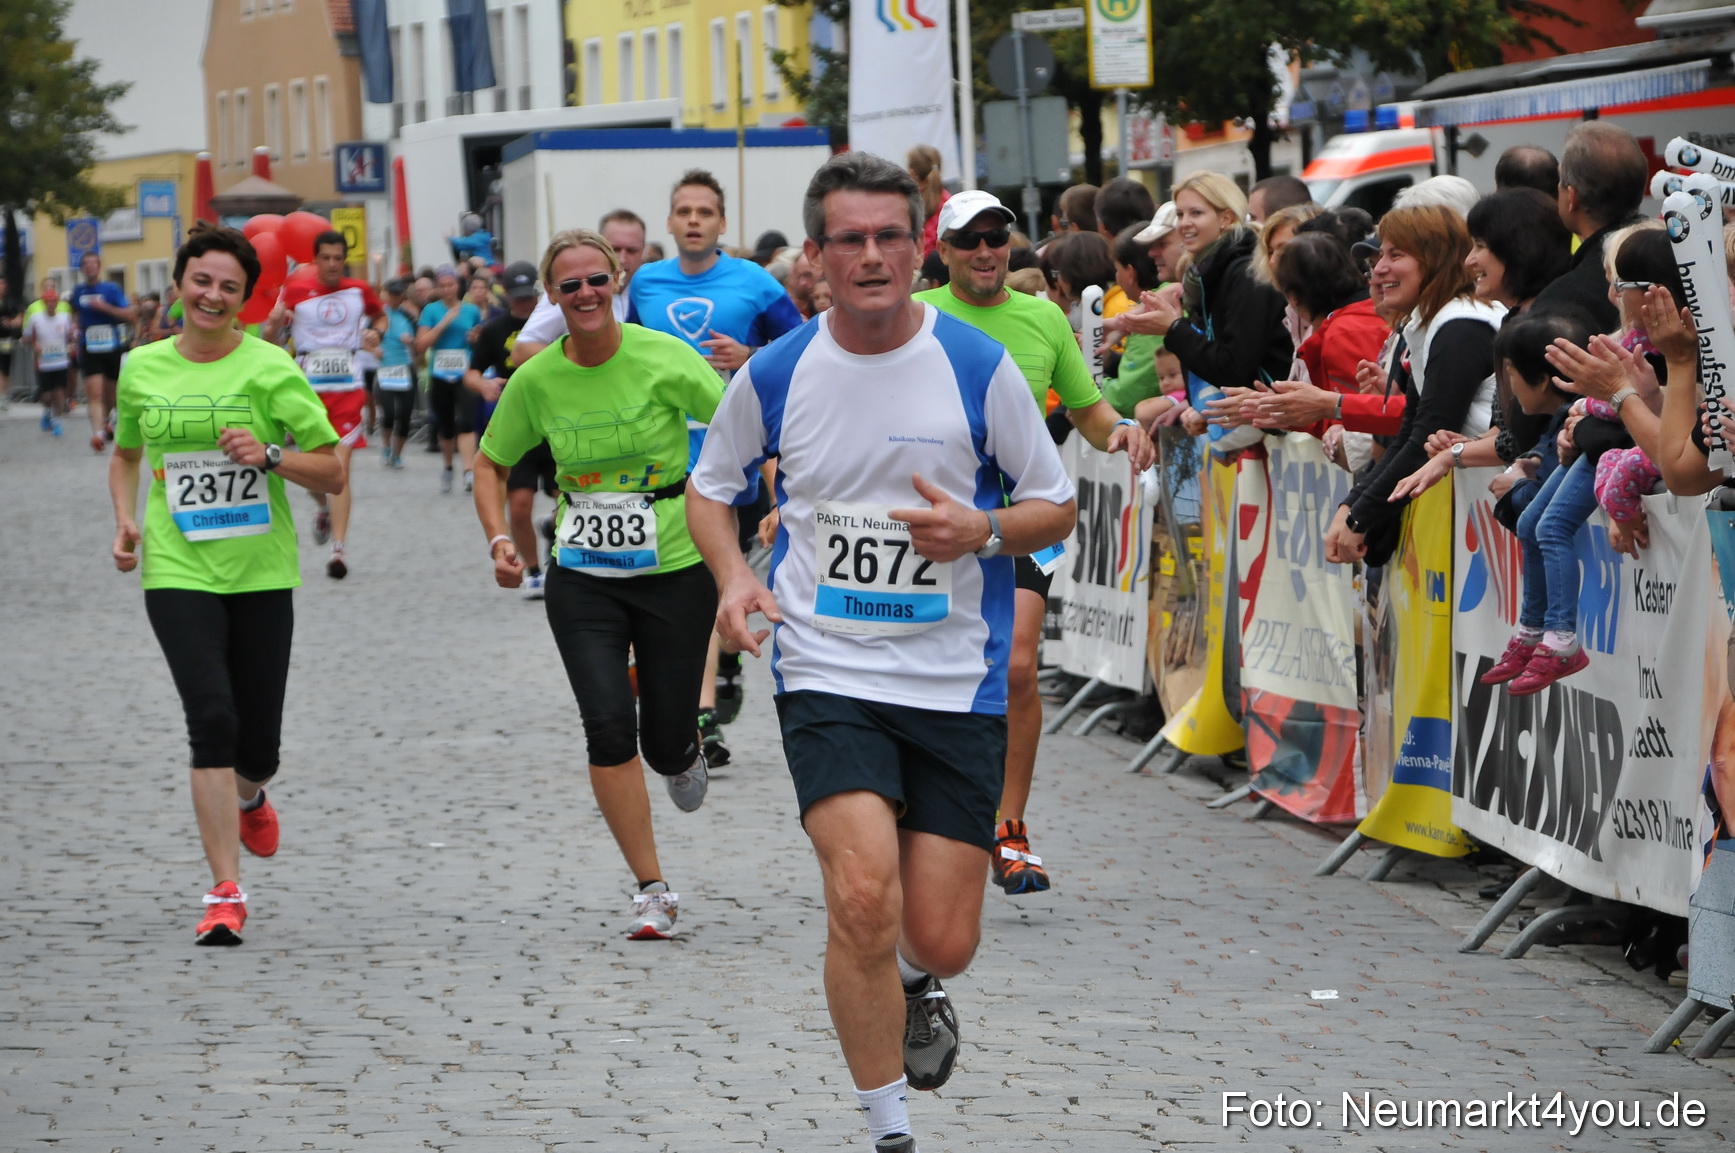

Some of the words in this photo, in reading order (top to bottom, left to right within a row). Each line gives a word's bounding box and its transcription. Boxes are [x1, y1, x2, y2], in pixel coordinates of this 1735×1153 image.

[888, 435, 916, 443] Klinikum
[916, 436, 945, 446] Nürnberg
[166, 461, 201, 470] PARTL
[202, 459, 236, 469] Neuma
[177, 468, 259, 507] 2372
[592, 500, 637, 510] Neumarkt
[192, 512, 250, 528] Christine
[816, 512, 859, 528] PARTL
[862, 517, 910, 532] Neuma
[567, 513, 647, 548] 2383
[580, 552, 635, 567] Theresia
[827, 533, 938, 586] 2672
[843, 595, 915, 619] Thomas
[1611, 798, 1663, 843] 92318
